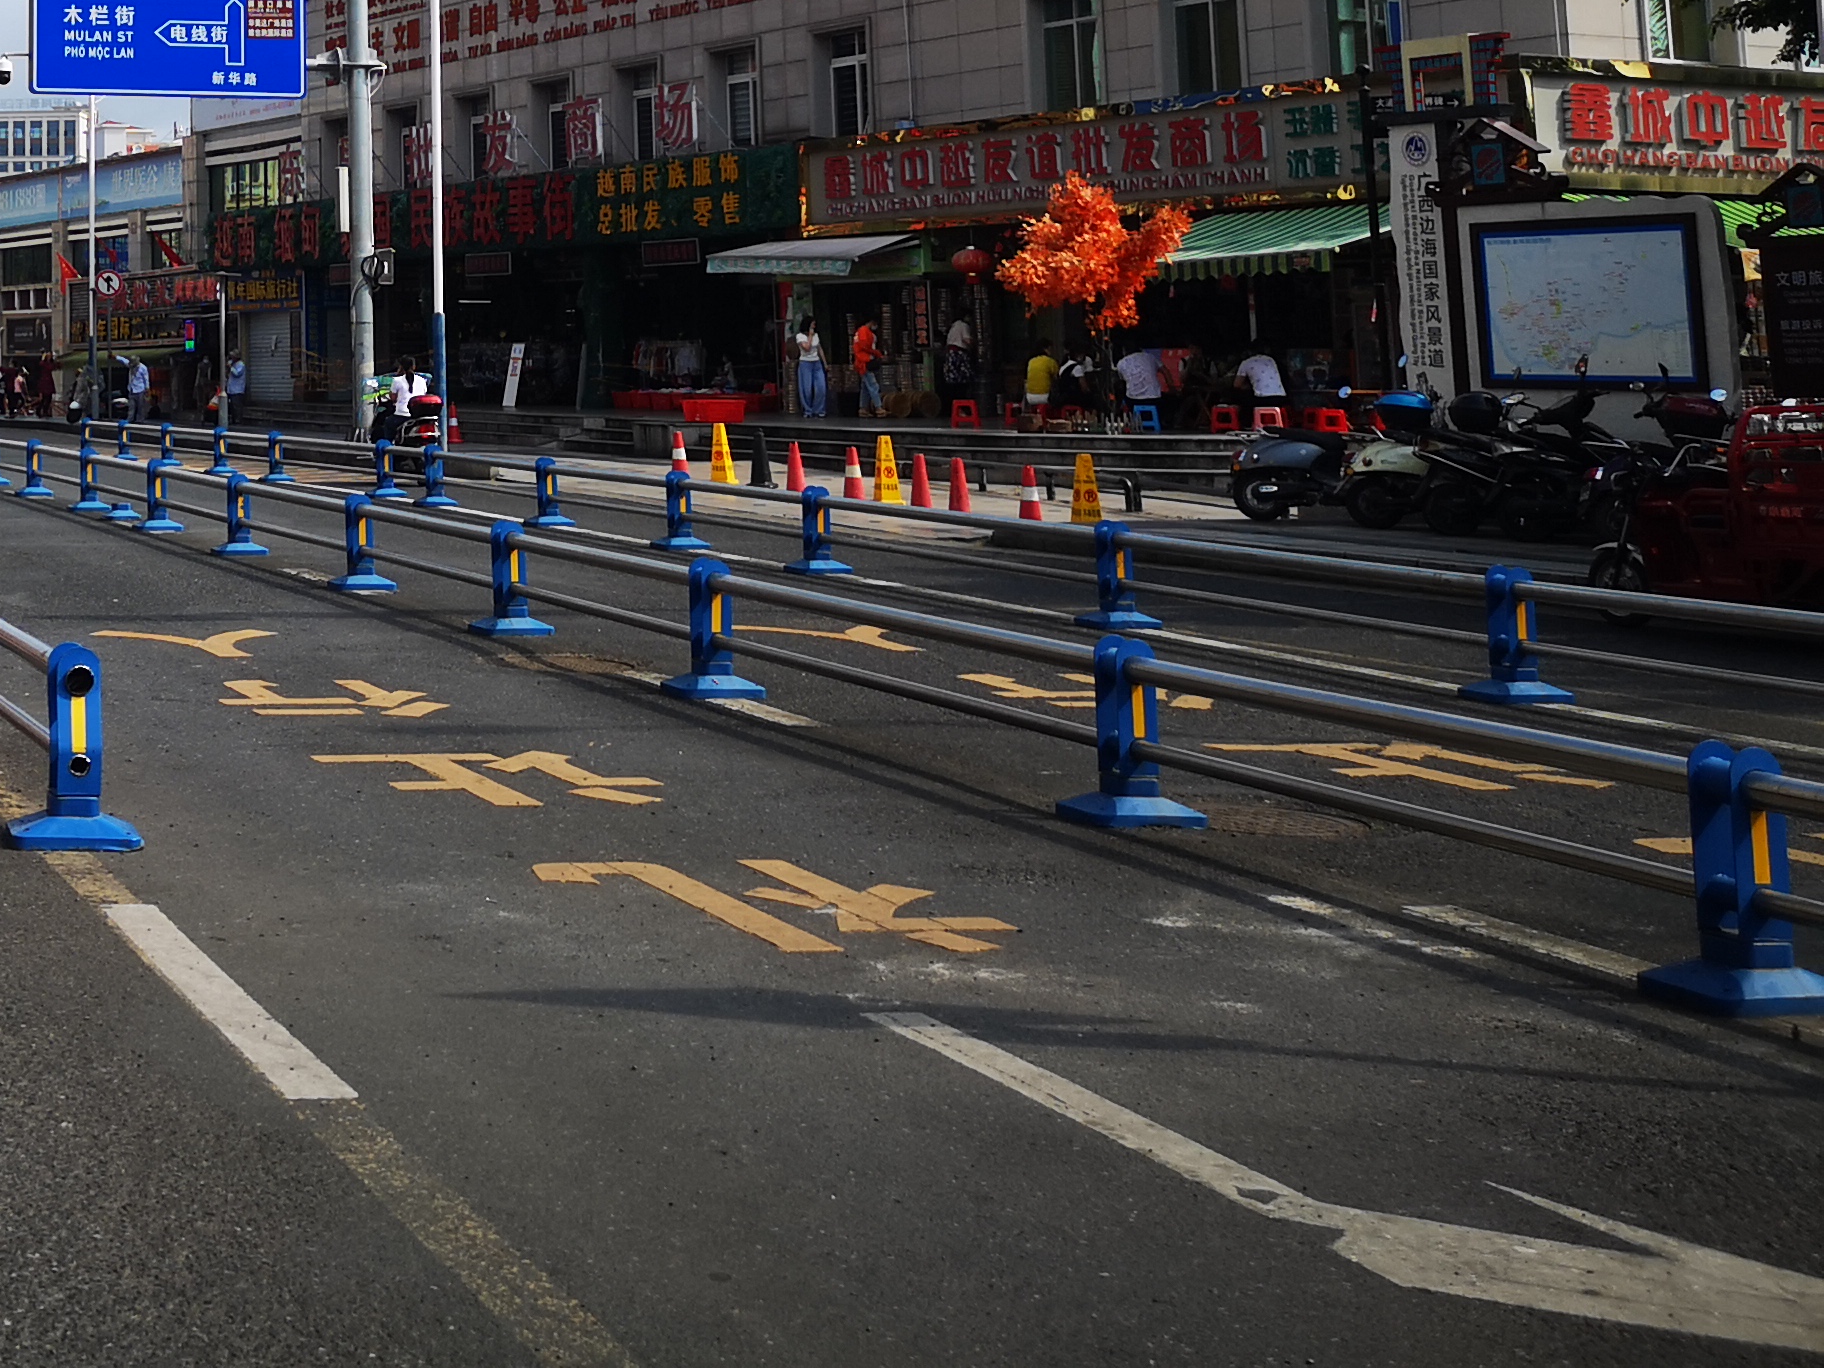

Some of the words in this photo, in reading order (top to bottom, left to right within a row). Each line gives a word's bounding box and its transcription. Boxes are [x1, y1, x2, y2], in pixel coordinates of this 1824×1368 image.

[62, 3, 136, 27] 木栏街
[468, 0, 499, 37] 自由
[64, 28, 113, 43] MULAN
[117, 30, 135, 43] ST
[113, 46, 134, 59] LAN
[170, 24, 228, 44] 电线街
[211, 70, 258, 87] 新华路
[823, 110, 1268, 201] 鑫城中越友谊批发商场
[596, 151, 740, 199] 越南民族服饰
[1408, 174, 1418, 213] Guangxi
[213, 210, 256, 267] 越南
[1415, 268, 1424, 307] National
[1417, 171, 1445, 369] 广西边海国家风景道
[1417, 309, 1426, 340] Scenic
